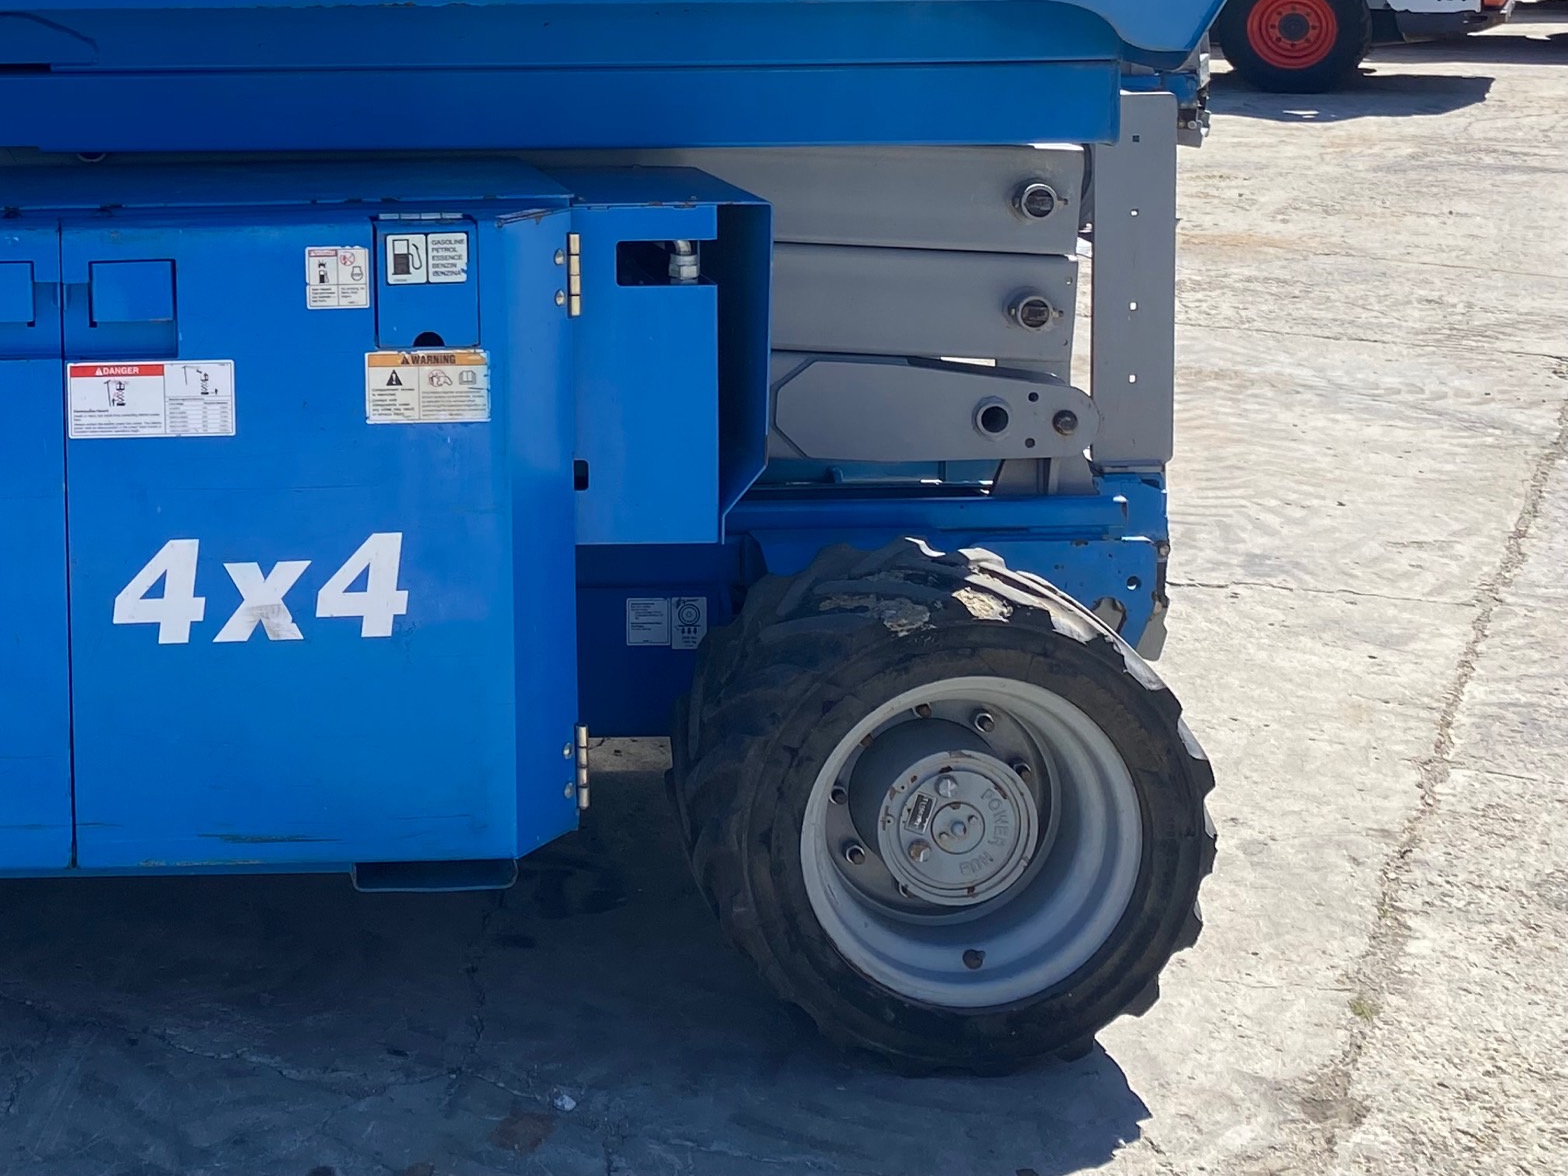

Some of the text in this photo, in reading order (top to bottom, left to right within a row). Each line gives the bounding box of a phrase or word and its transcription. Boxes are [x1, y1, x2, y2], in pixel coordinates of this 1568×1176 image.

[431, 238, 465, 246] GASOLINE
[431, 254, 463, 262] ESSENCE
[411, 354, 456, 365] WARNING
[102, 366, 140, 375] DANGER
[112, 531, 409, 645] 4x4
[981, 788, 1009, 847] POWER
[959, 853, 995, 875] HUB
